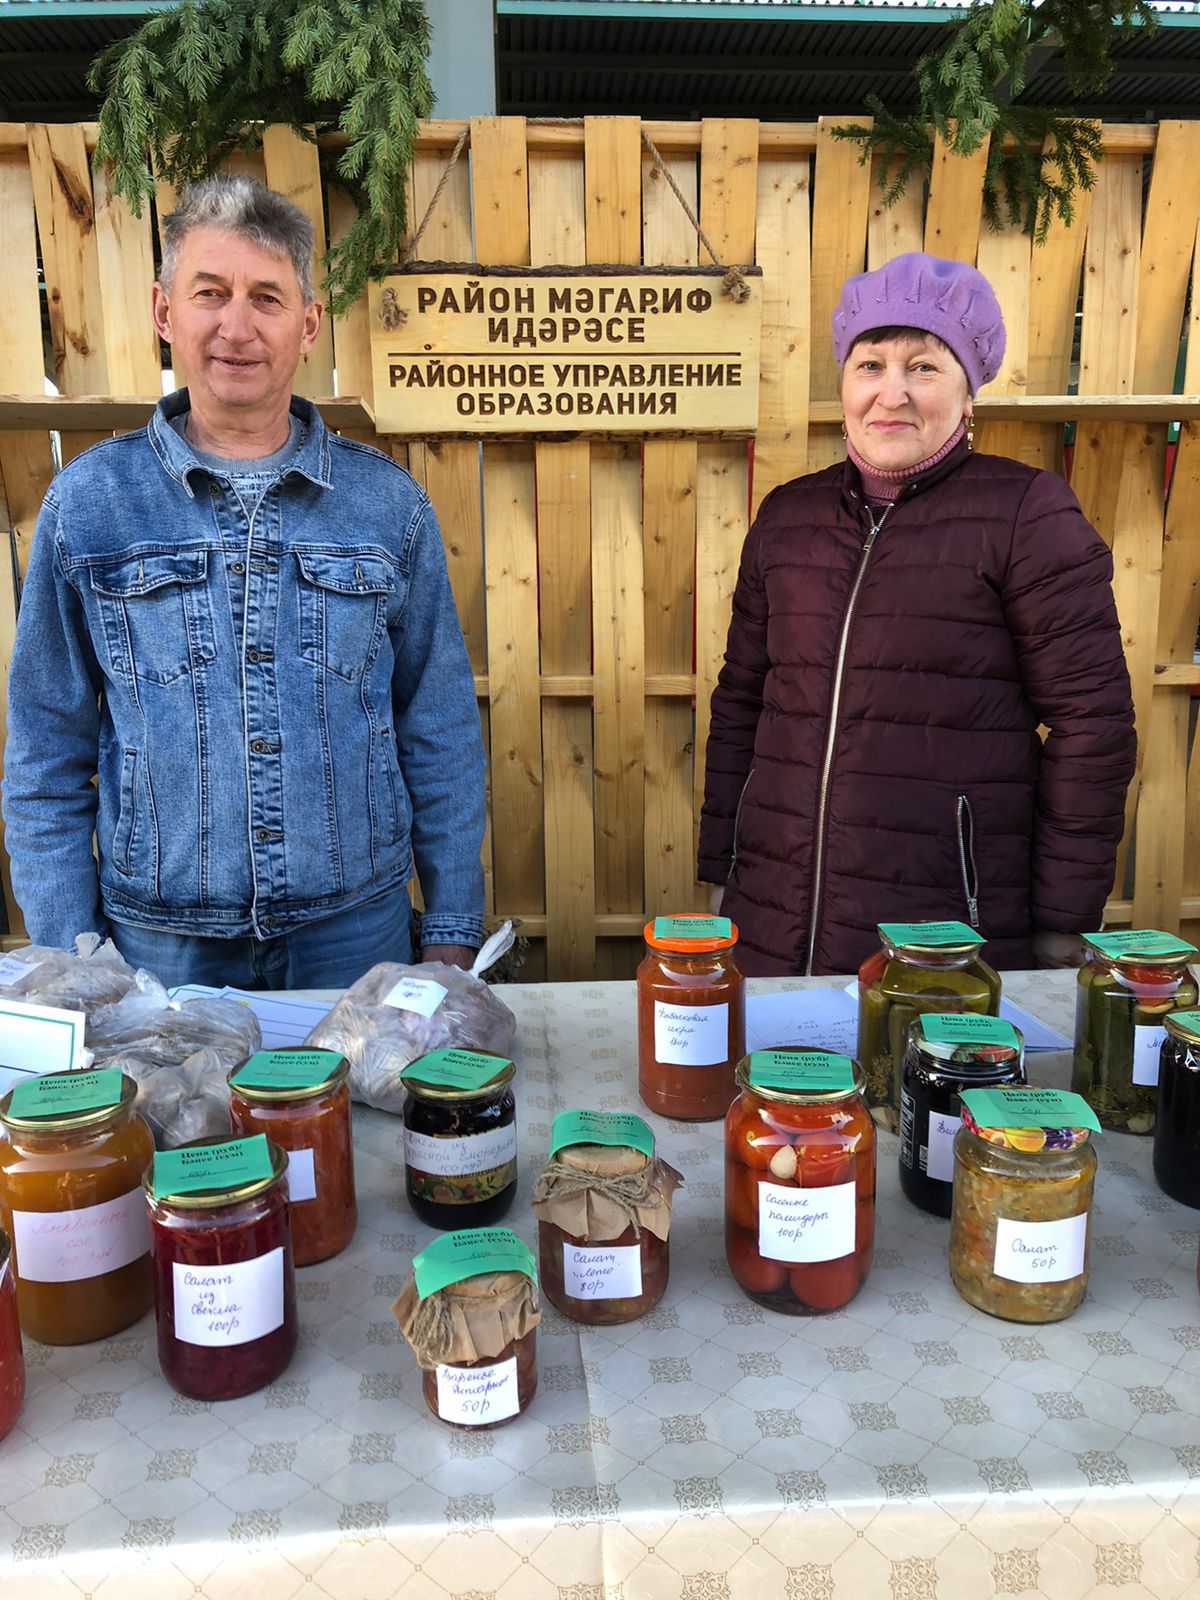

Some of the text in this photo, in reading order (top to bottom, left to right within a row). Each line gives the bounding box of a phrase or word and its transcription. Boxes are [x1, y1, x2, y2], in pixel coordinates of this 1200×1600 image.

[417, 281, 713, 314] РАЙОН МӘГАРИФ
[488, 317, 645, 348] ИДӘРӘСЕ
[389, 360, 742, 388] РАЙОННОЕ УПРАВЛЕНИЕ
[456, 392, 677, 416] ОБРАЗОВАНИЯ
